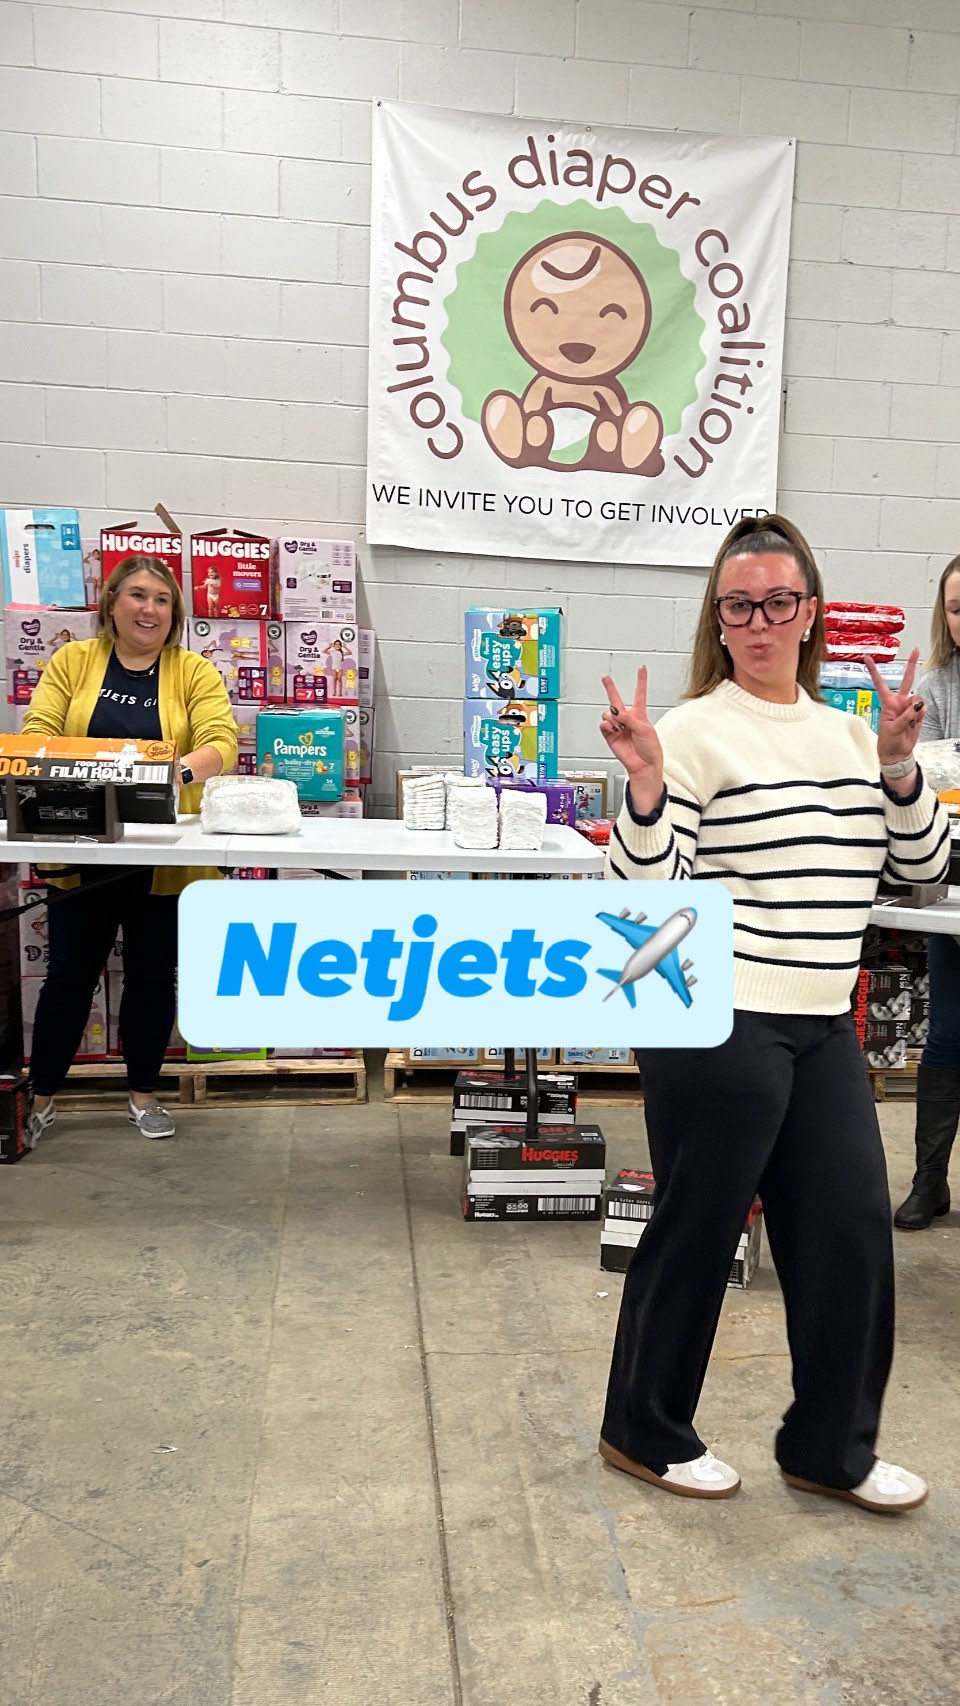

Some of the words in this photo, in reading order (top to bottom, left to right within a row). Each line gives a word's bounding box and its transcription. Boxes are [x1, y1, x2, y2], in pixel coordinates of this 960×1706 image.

[387, 169, 497, 460] columbus
[507, 134, 700, 219] diaper
[673, 228, 766, 478] coalition
[372, 483, 411, 505] WE
[418, 487, 495, 512] INVITE
[503, 494, 553, 517] YOU
[561, 498, 593, 519] TO
[600, 501, 647, 523] GET
[102, 533, 182, 554] HUGGIES
[191, 539, 270, 559] HUGGIES
[23, 543, 32, 574] diapers
[237, 562, 257, 570] little
[259, 604, 268, 616] 7
[492, 640, 503, 669] easy
[502, 643, 513, 667] ups
[306, 690, 313, 698] 7
[273, 738, 327, 758] Pampers
[491, 726, 502, 755] easy
[502, 729, 512, 752] ups
[49, 765, 89, 779] FILM
[91, 767, 131, 780] ROLL
[75, 760, 98, 768] FOOD
[521, 1147, 579, 1162] HUGGIES
